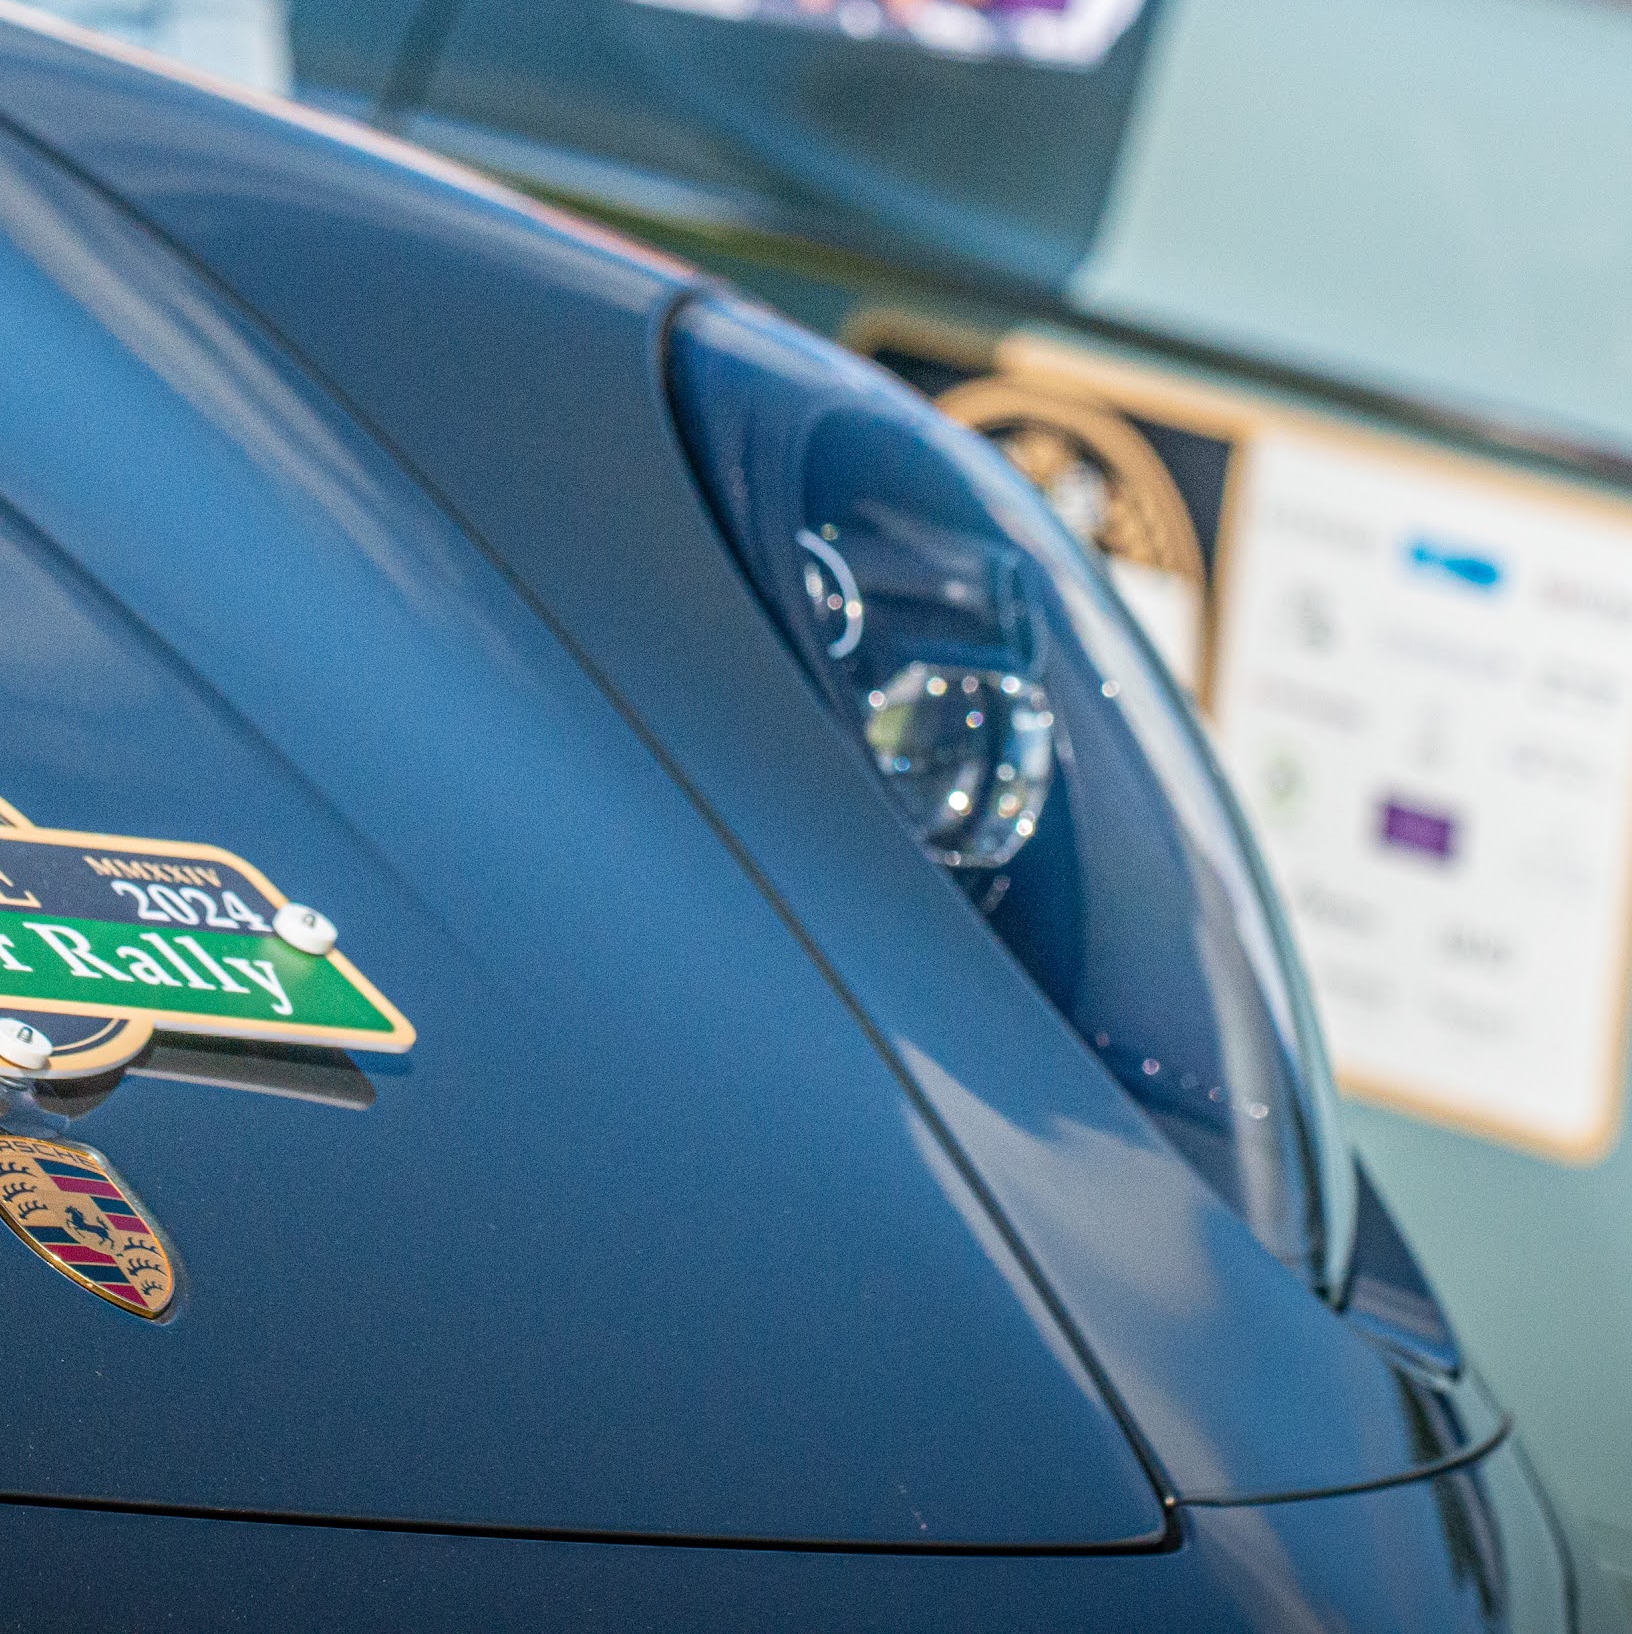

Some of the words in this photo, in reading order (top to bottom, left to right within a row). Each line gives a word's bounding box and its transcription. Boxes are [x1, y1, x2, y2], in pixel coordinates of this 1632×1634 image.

[83, 855, 222, 888] MMXXIV
[111, 880, 273, 933] 2024
[23, 922, 294, 1016] Rally
